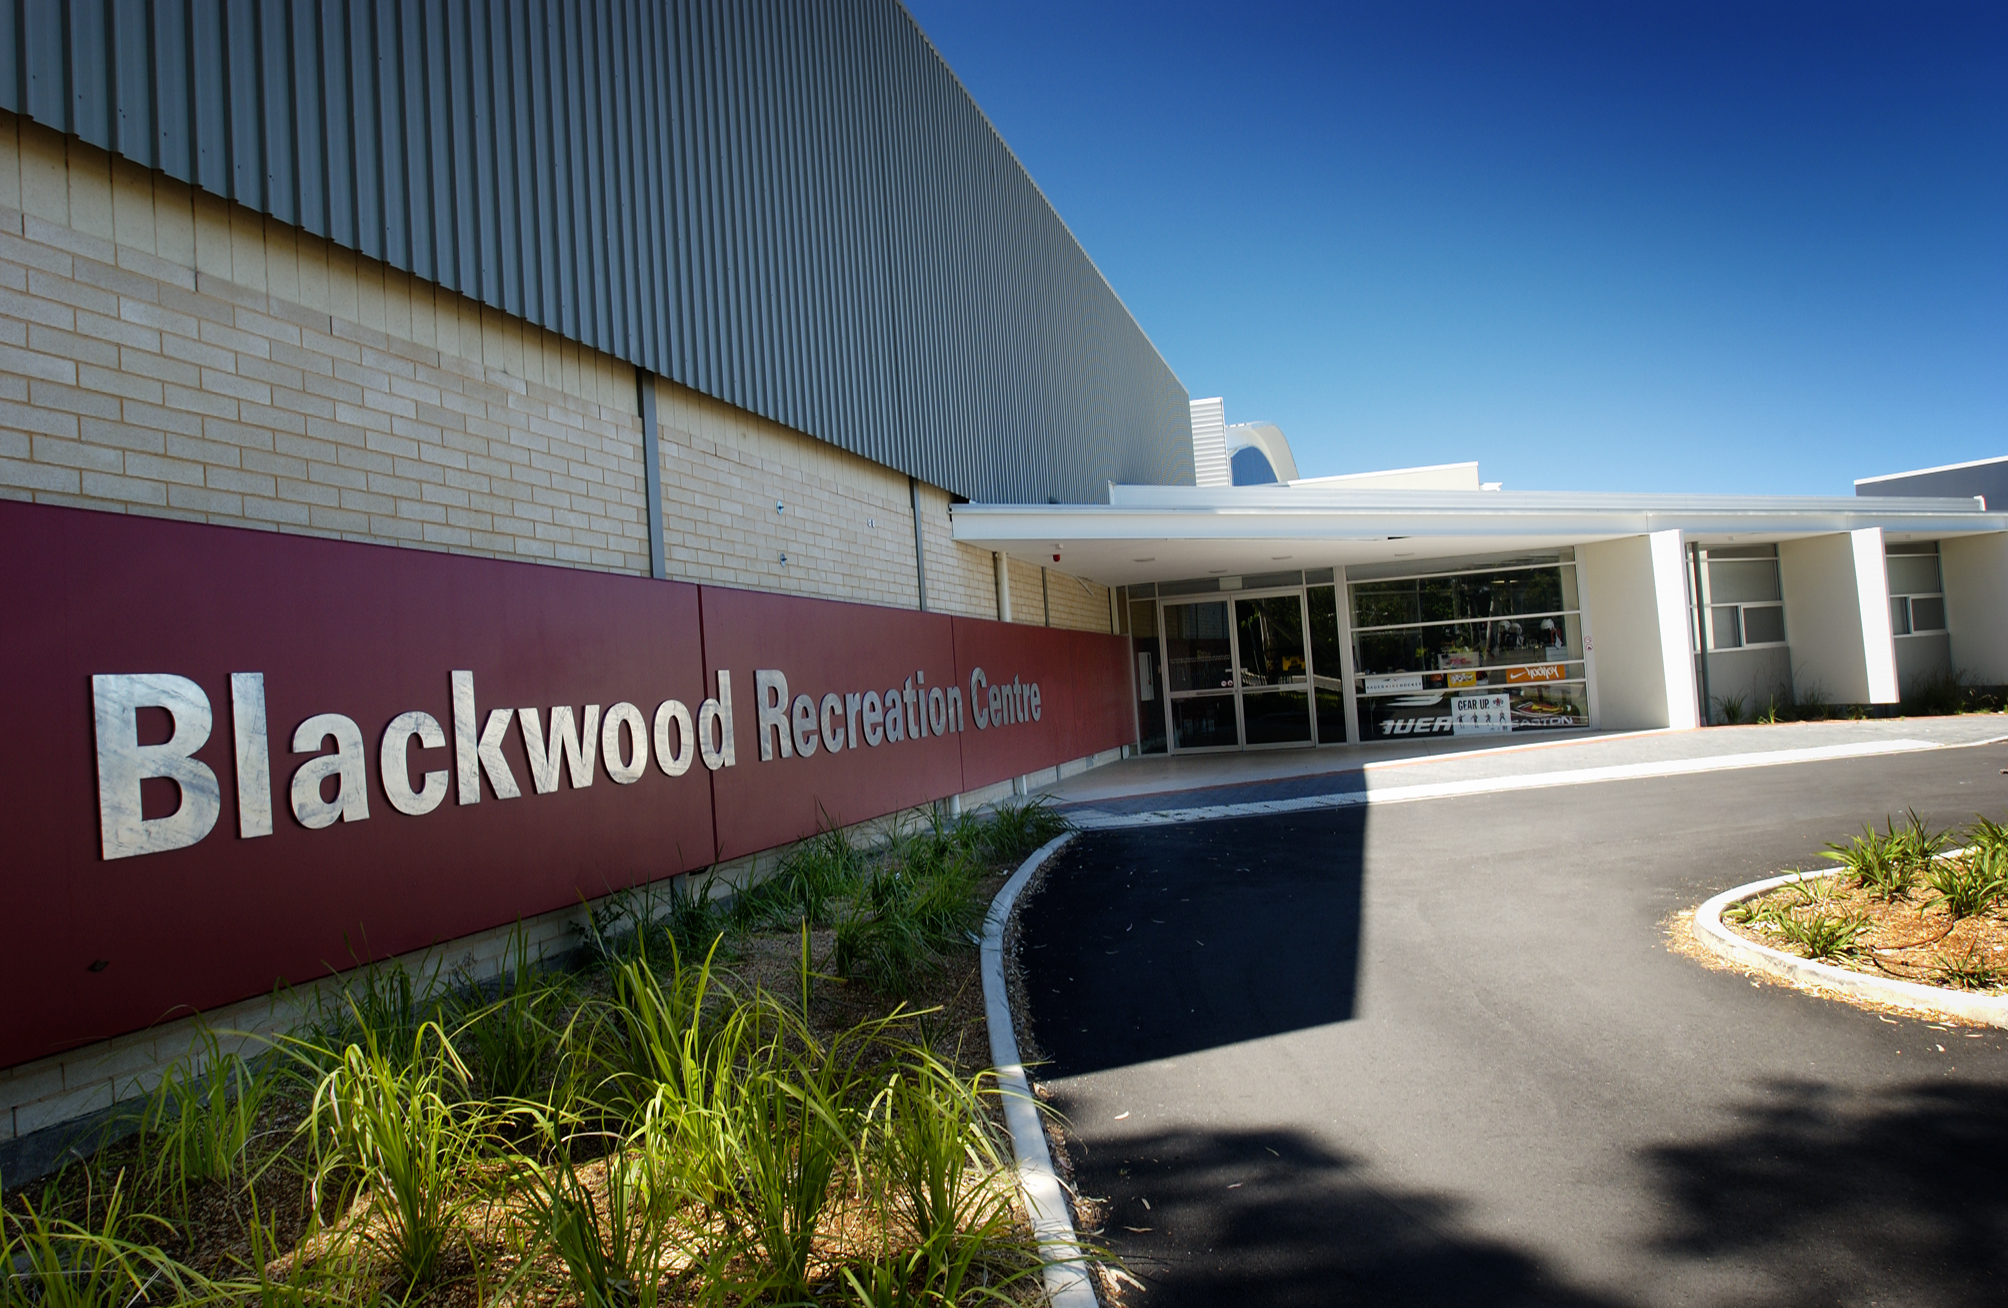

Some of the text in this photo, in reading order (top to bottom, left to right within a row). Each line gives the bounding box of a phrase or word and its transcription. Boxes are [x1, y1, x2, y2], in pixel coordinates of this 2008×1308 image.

[1457, 699, 1478, 711] GEAR
[91, 666, 1042, 861] Blackwood Recreation Centre
